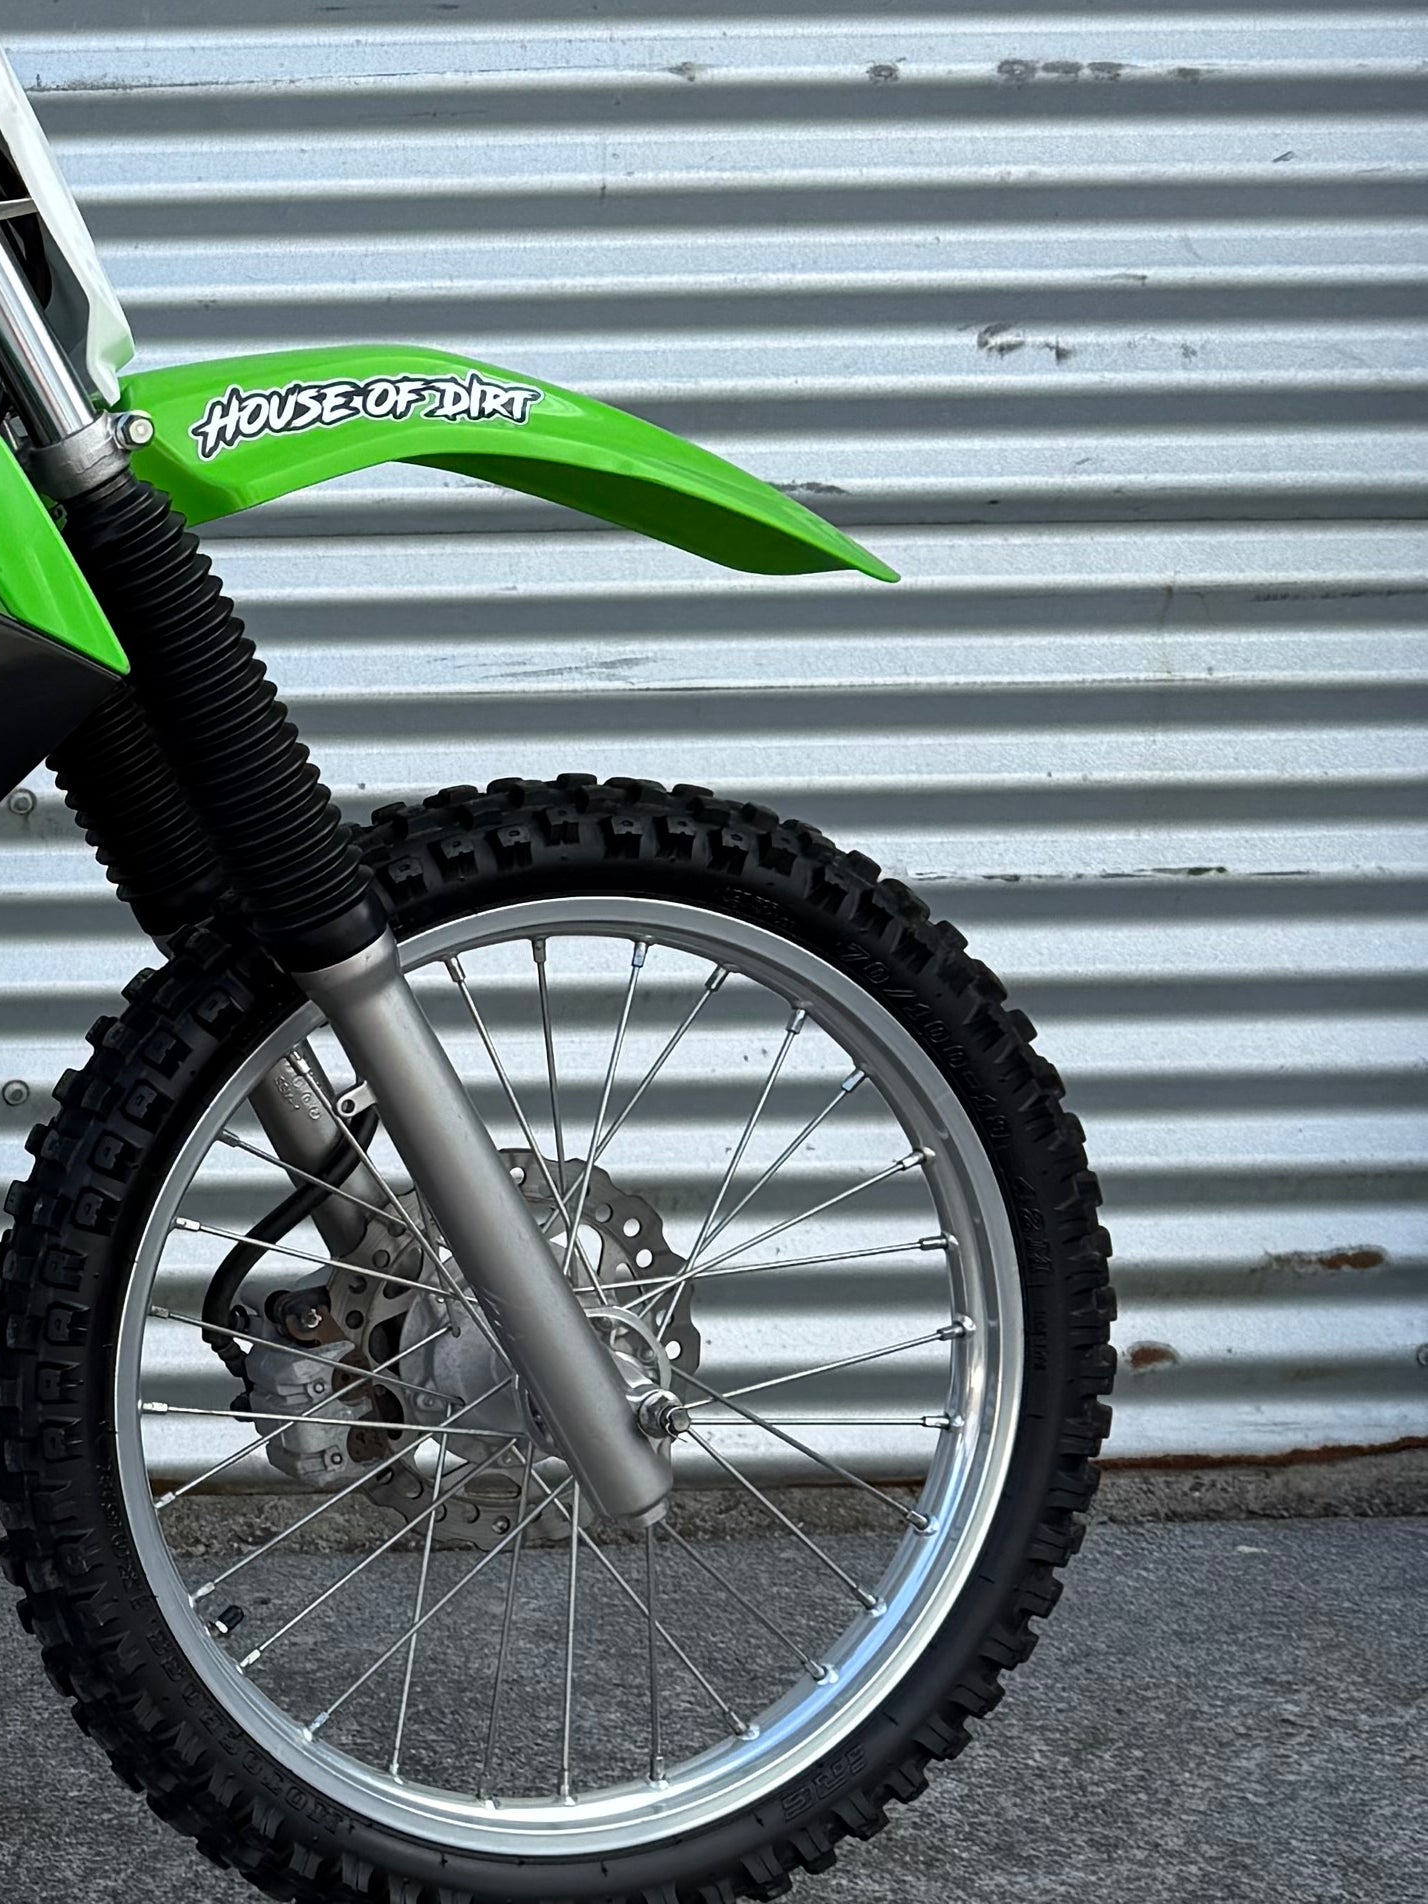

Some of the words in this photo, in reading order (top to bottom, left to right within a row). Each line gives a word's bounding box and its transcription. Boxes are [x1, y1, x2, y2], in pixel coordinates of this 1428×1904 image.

[194, 382, 355, 457] HOUSE
[364, 378, 426, 420] OF
[430, 373, 539, 423] DIRT
